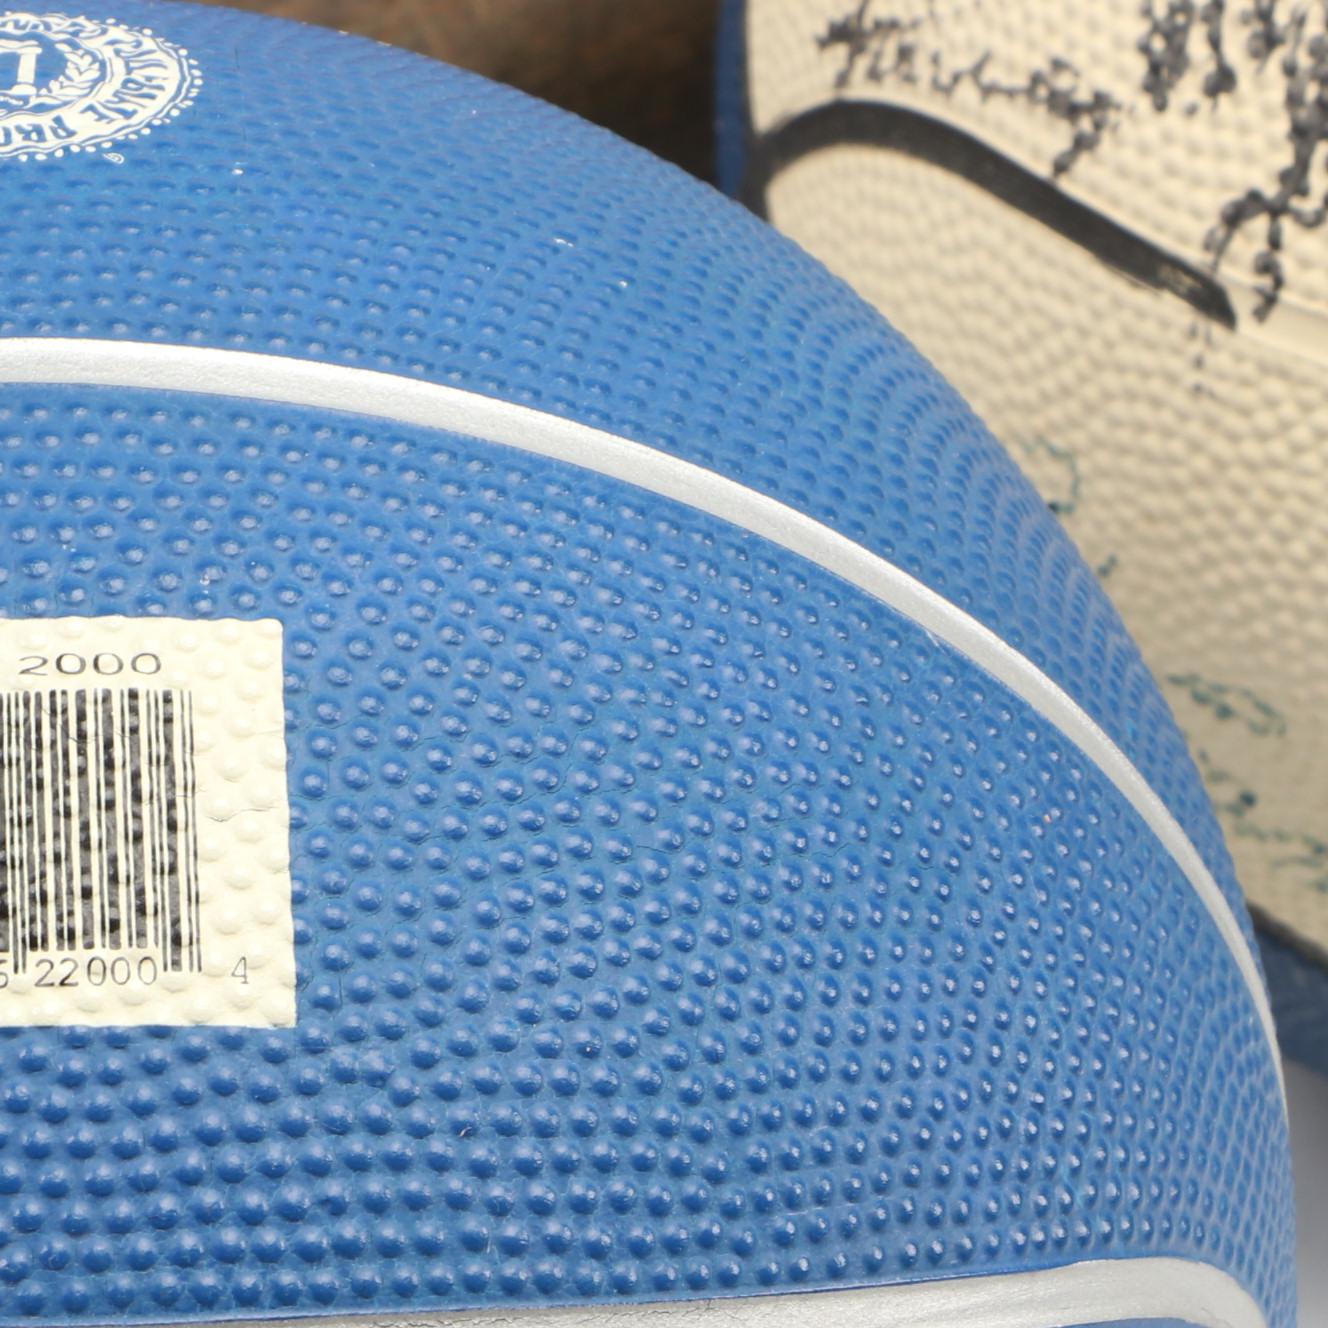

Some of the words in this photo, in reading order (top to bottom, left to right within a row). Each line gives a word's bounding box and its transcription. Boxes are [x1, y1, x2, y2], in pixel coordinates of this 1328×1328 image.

[18, 652, 163, 677] 2000
[34, 955, 159, 988] 22000
[231, 955, 250, 985] 4
